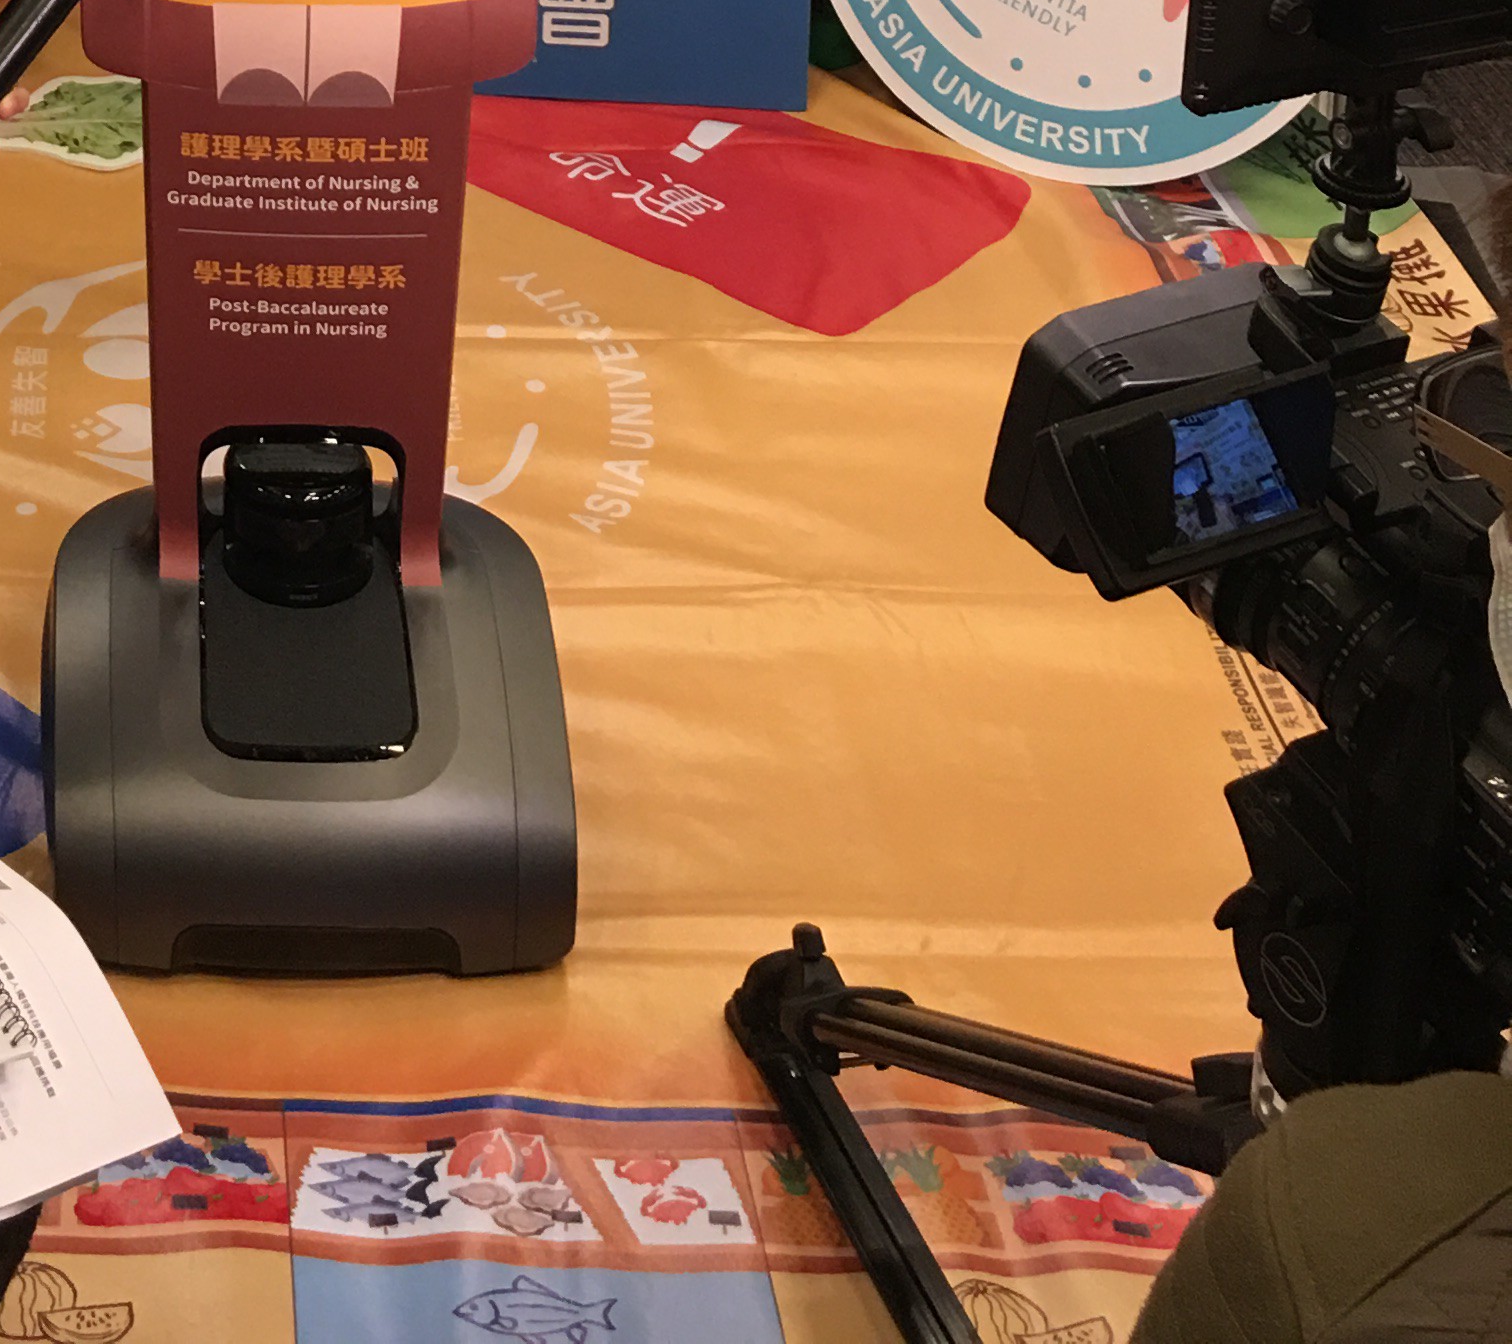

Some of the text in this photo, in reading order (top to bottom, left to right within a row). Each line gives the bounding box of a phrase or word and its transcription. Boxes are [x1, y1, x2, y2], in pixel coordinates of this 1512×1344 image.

[933, 63, 1151, 156] UNIVERSITY
[180, 132, 430, 164] 護理學系暨碩士班
[188, 170, 420, 195] Department of Nursing &
[167, 191, 439, 215] Graduate Institute of Nursing
[193, 259, 407, 291] 學士後護理學系
[208, 297, 389, 318] Post-Baccalaureate
[208, 317, 388, 340] Program in Nursing
[498, 270, 654, 535] ASIA UNIVERSITY
[1208, 623, 1264, 725] RESPONSIBILIT
